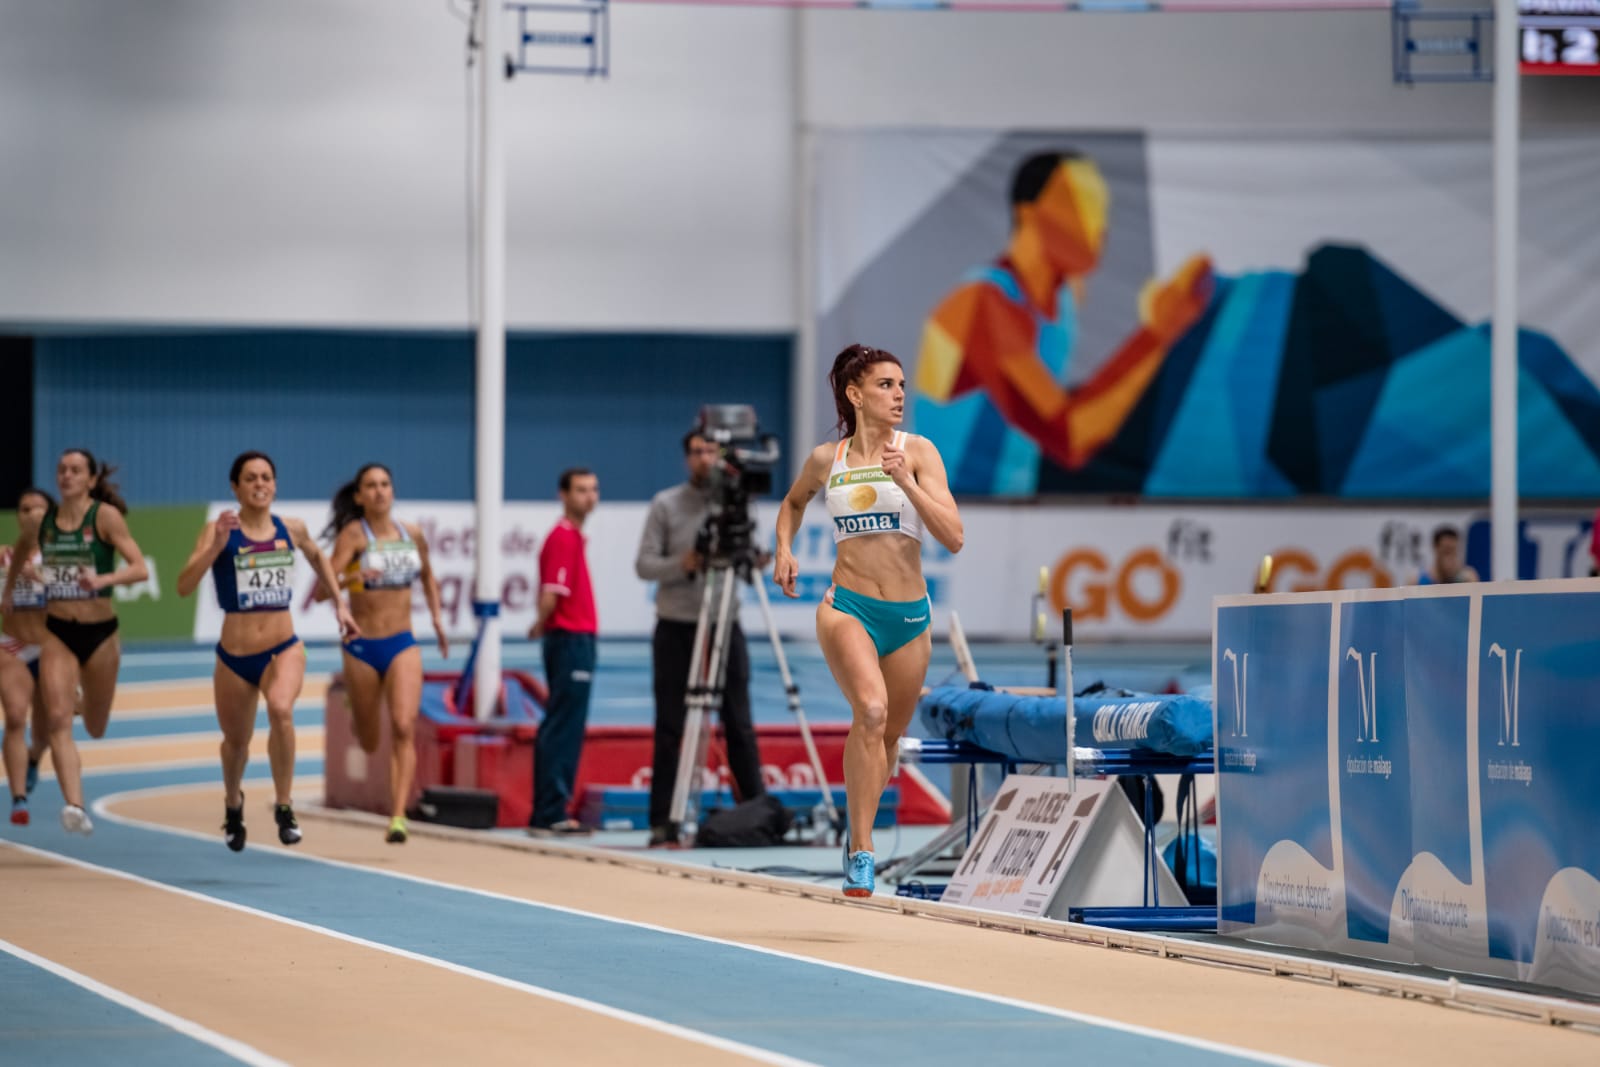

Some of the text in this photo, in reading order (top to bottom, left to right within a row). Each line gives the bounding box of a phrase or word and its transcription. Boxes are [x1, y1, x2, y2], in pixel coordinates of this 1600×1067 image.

[50, 566, 78, 585] 36
[249, 568, 286, 588] 428
[1050, 547, 1183, 623] GO
[1263, 872, 1332, 920] Diputación es deporte
[1441, 890, 1468, 936] deporte
